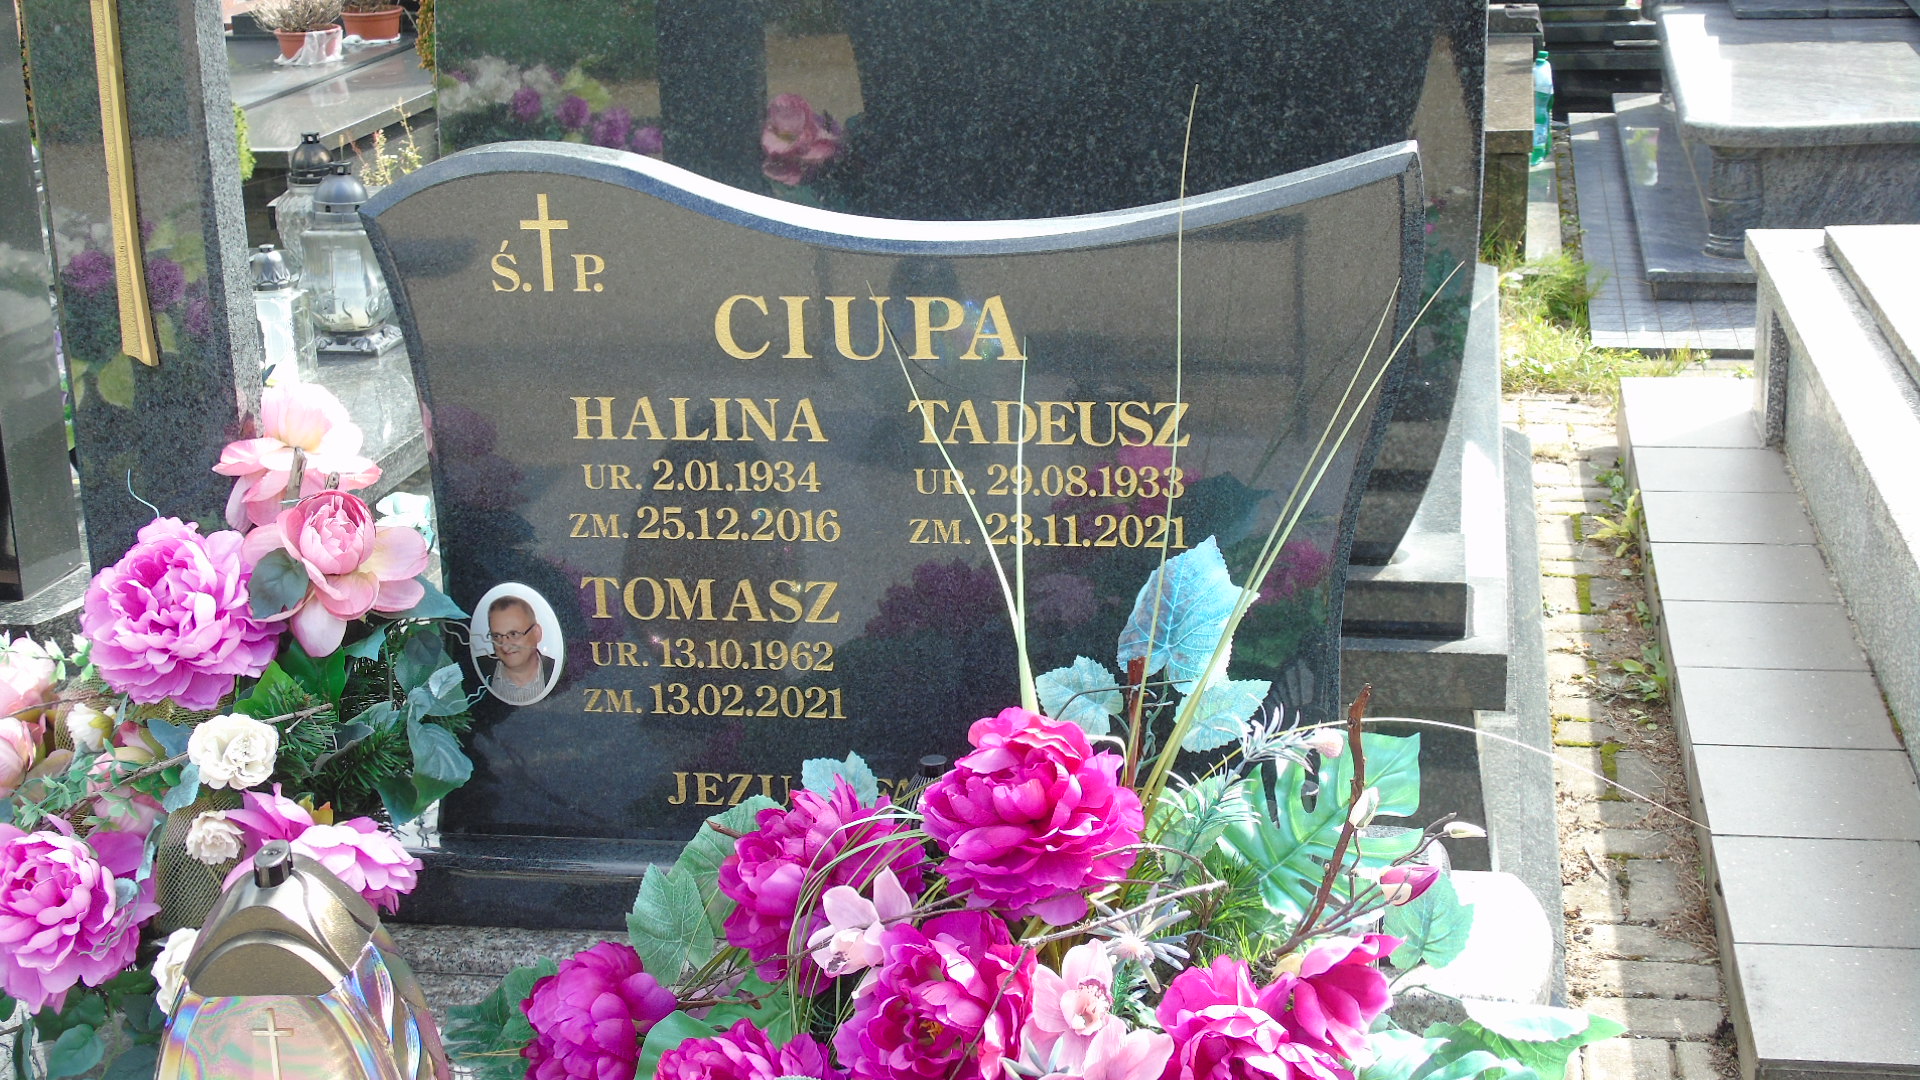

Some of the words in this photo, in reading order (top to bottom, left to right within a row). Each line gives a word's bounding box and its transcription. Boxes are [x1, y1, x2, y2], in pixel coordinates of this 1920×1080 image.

[573, 253, 606, 292] P.
[713, 294, 1027, 361] CIUPA
[570, 396, 829, 442] HALINA
[908, 400, 1191, 448] TADEUSZ
[582, 463, 643, 490] UR.
[652, 459, 822, 493] 2.01.1934
[914, 468, 975, 496] UR.
[986, 464, 1185, 499] 29.08.1933
[569, 512, 629, 539] ZM.
[636, 506, 841, 542] 25.12.2016
[909, 518, 971, 545] ZM.
[986, 513, 1186, 549] 23.11.2021
[580, 577, 841, 624] TOMASZ
[589, 641, 649, 667] UR.
[659, 638, 835, 672] 13.10.1962
[582, 688, 643, 714] ZM.
[650, 683, 848, 720] 13.02.2021
